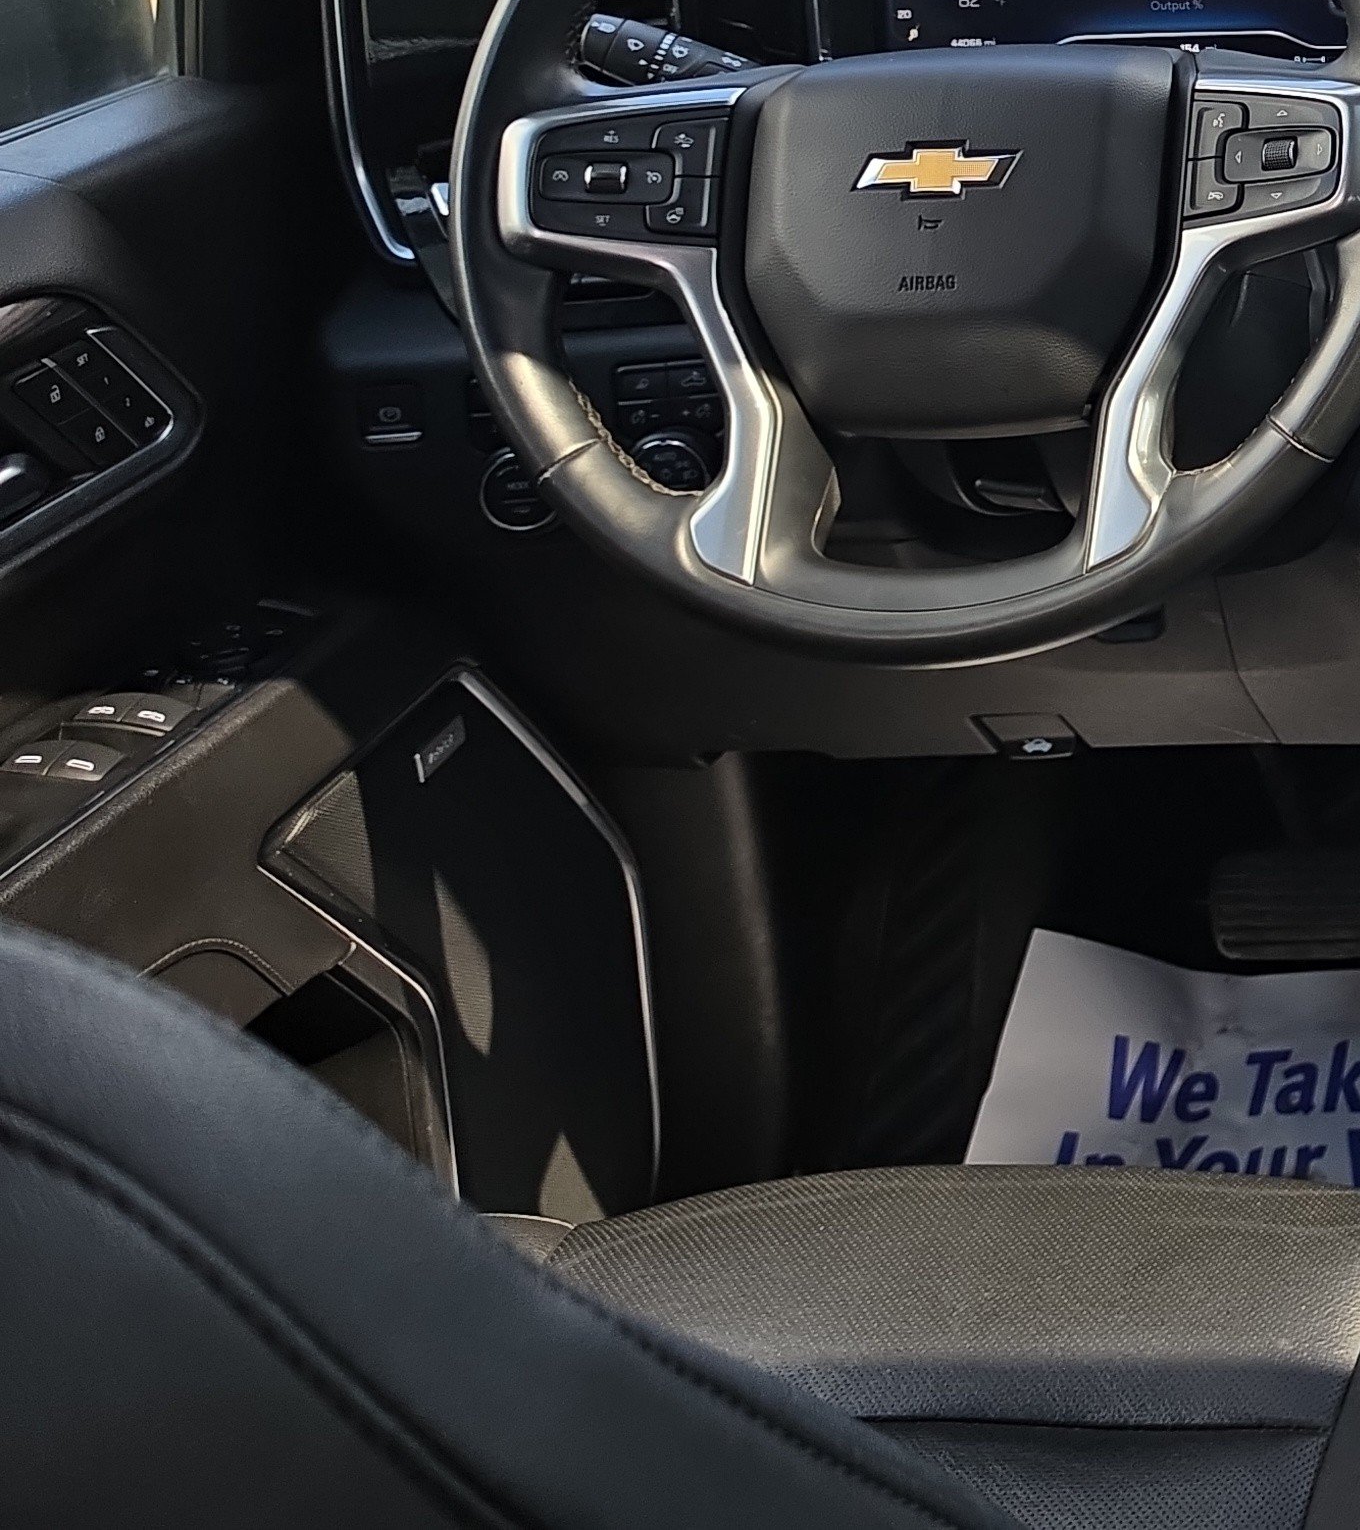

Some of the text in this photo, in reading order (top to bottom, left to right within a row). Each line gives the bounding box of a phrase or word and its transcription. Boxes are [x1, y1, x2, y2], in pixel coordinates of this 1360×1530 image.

[1150, 0, 1204, 12] Output %
[983, 37, 996, 47] mi
[898, 274, 957, 291] AIRBAG
[1108, 1034, 1219, 1123] We
